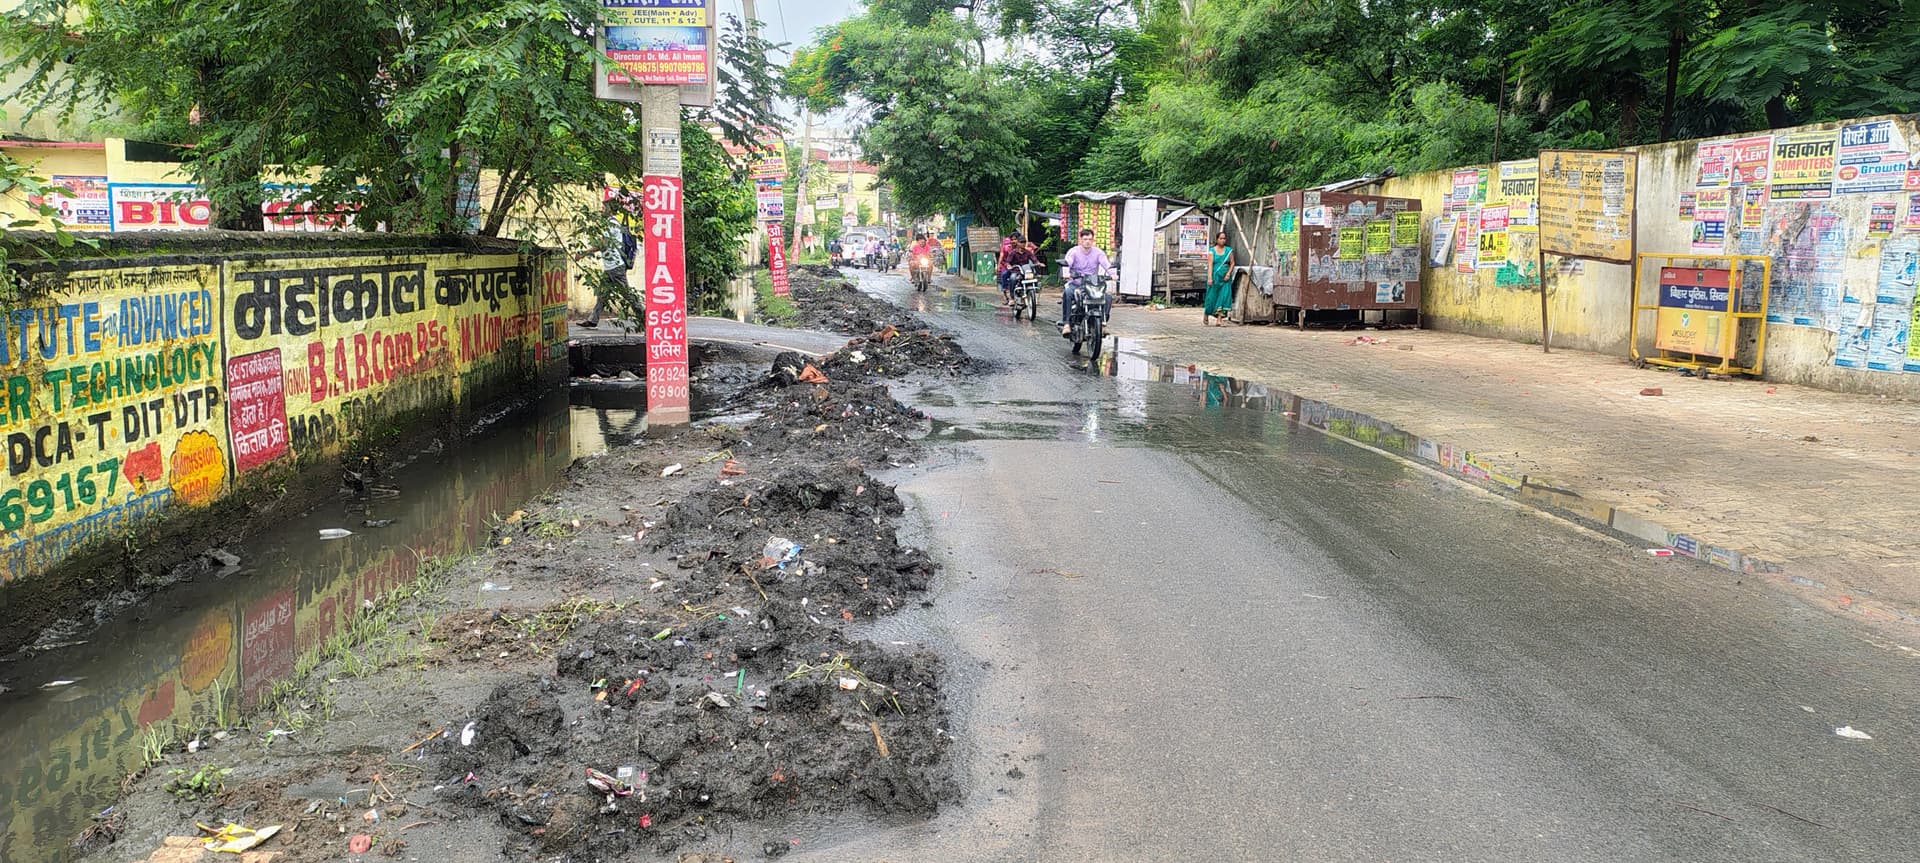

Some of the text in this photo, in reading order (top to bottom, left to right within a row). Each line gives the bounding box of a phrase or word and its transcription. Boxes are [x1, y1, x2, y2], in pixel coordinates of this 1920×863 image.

[1776, 140, 1836, 158] महाकाल
[1775, 157, 1833, 171] COMPUTERS
[1861, 164, 1906, 174] Growth
[1501, 178, 1537, 196] महाकाल
[233, 263, 427, 340] महाकाल
[1670, 286, 1688, 299] बिहार
[103, 313, 118, 339] FOR
[118, 289, 213, 347] ADVANCED
[648, 309, 682, 326] SSC
[653, 326, 683, 341] RLY.
[650, 340, 682, 359] पुलिस
[44, 341, 217, 413] TECHNOLOGY
[650, 366, 686, 383] 82924
[123, 398, 165, 443] DIT
[173, 386, 219, 429] DTP
[234, 418, 284, 459] किताब फ्री
